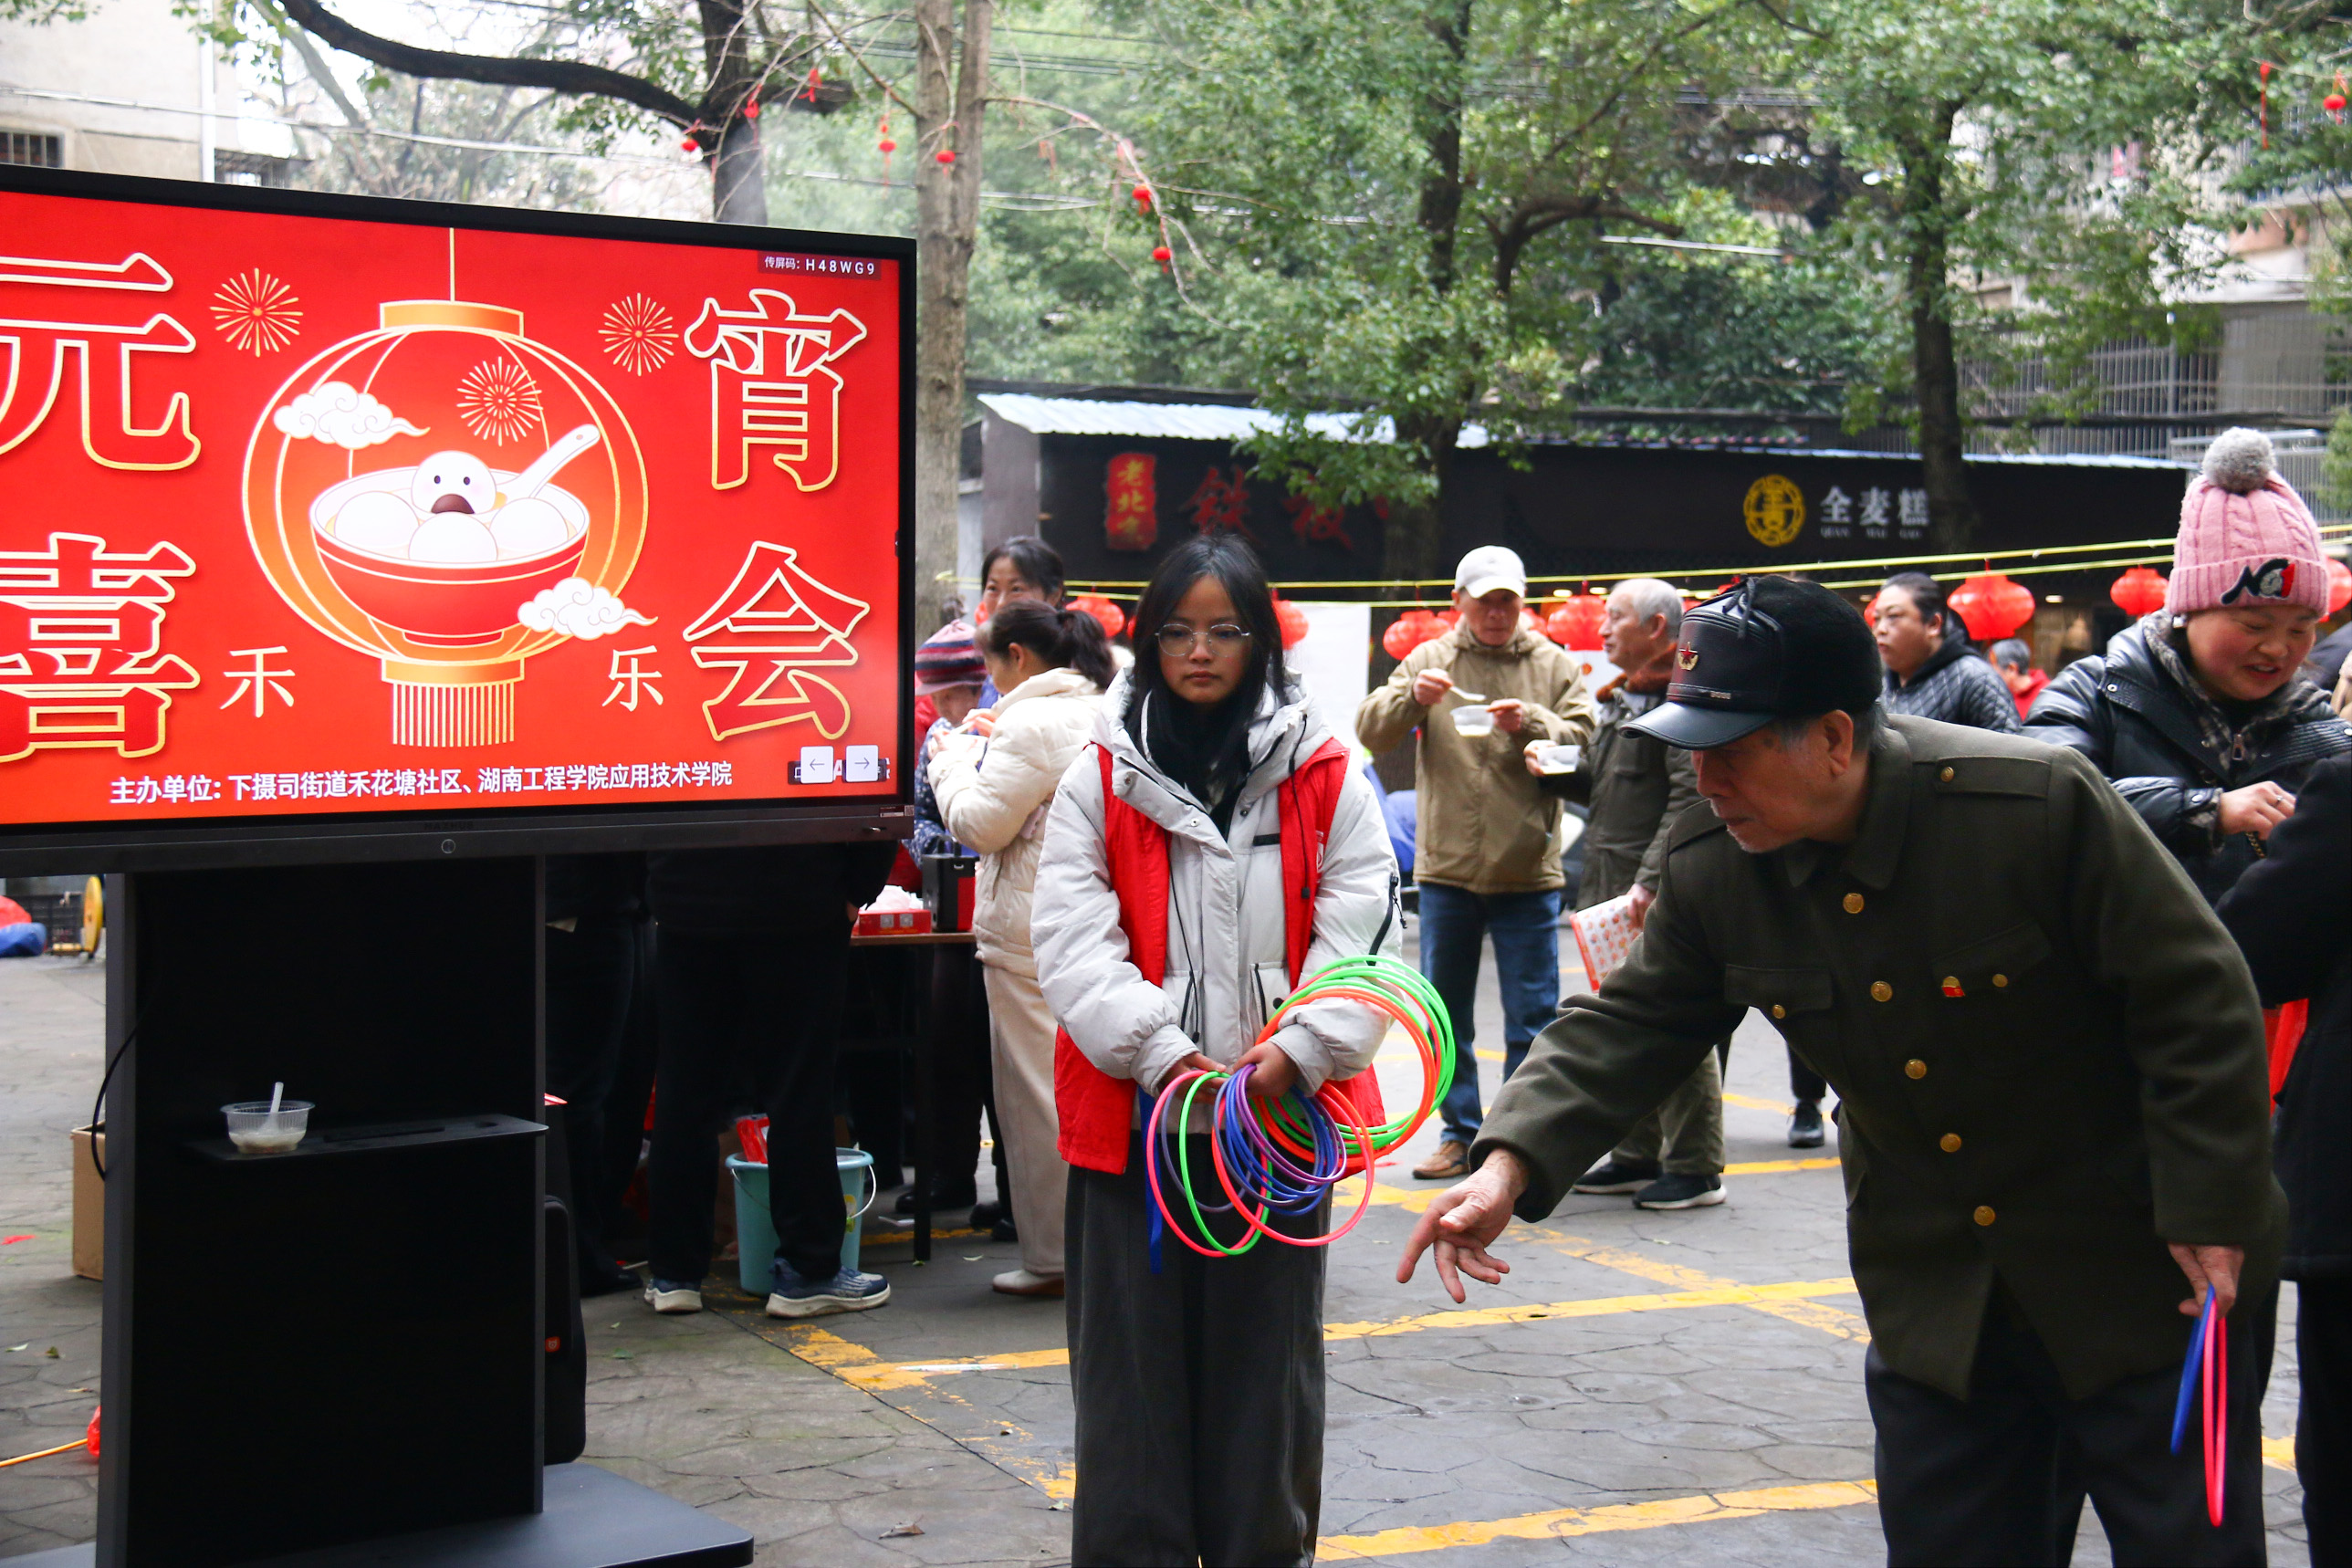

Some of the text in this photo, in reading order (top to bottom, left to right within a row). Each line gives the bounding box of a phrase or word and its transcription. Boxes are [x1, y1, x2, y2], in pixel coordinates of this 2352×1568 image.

[806, 258, 875, 275] H48WG9
[0, 252, 867, 492] 元 宵
[1820, 485, 1929, 527] 全麦糕
[0, 531, 871, 763] 喜 会
[220, 645, 664, 718] 禾 乐
